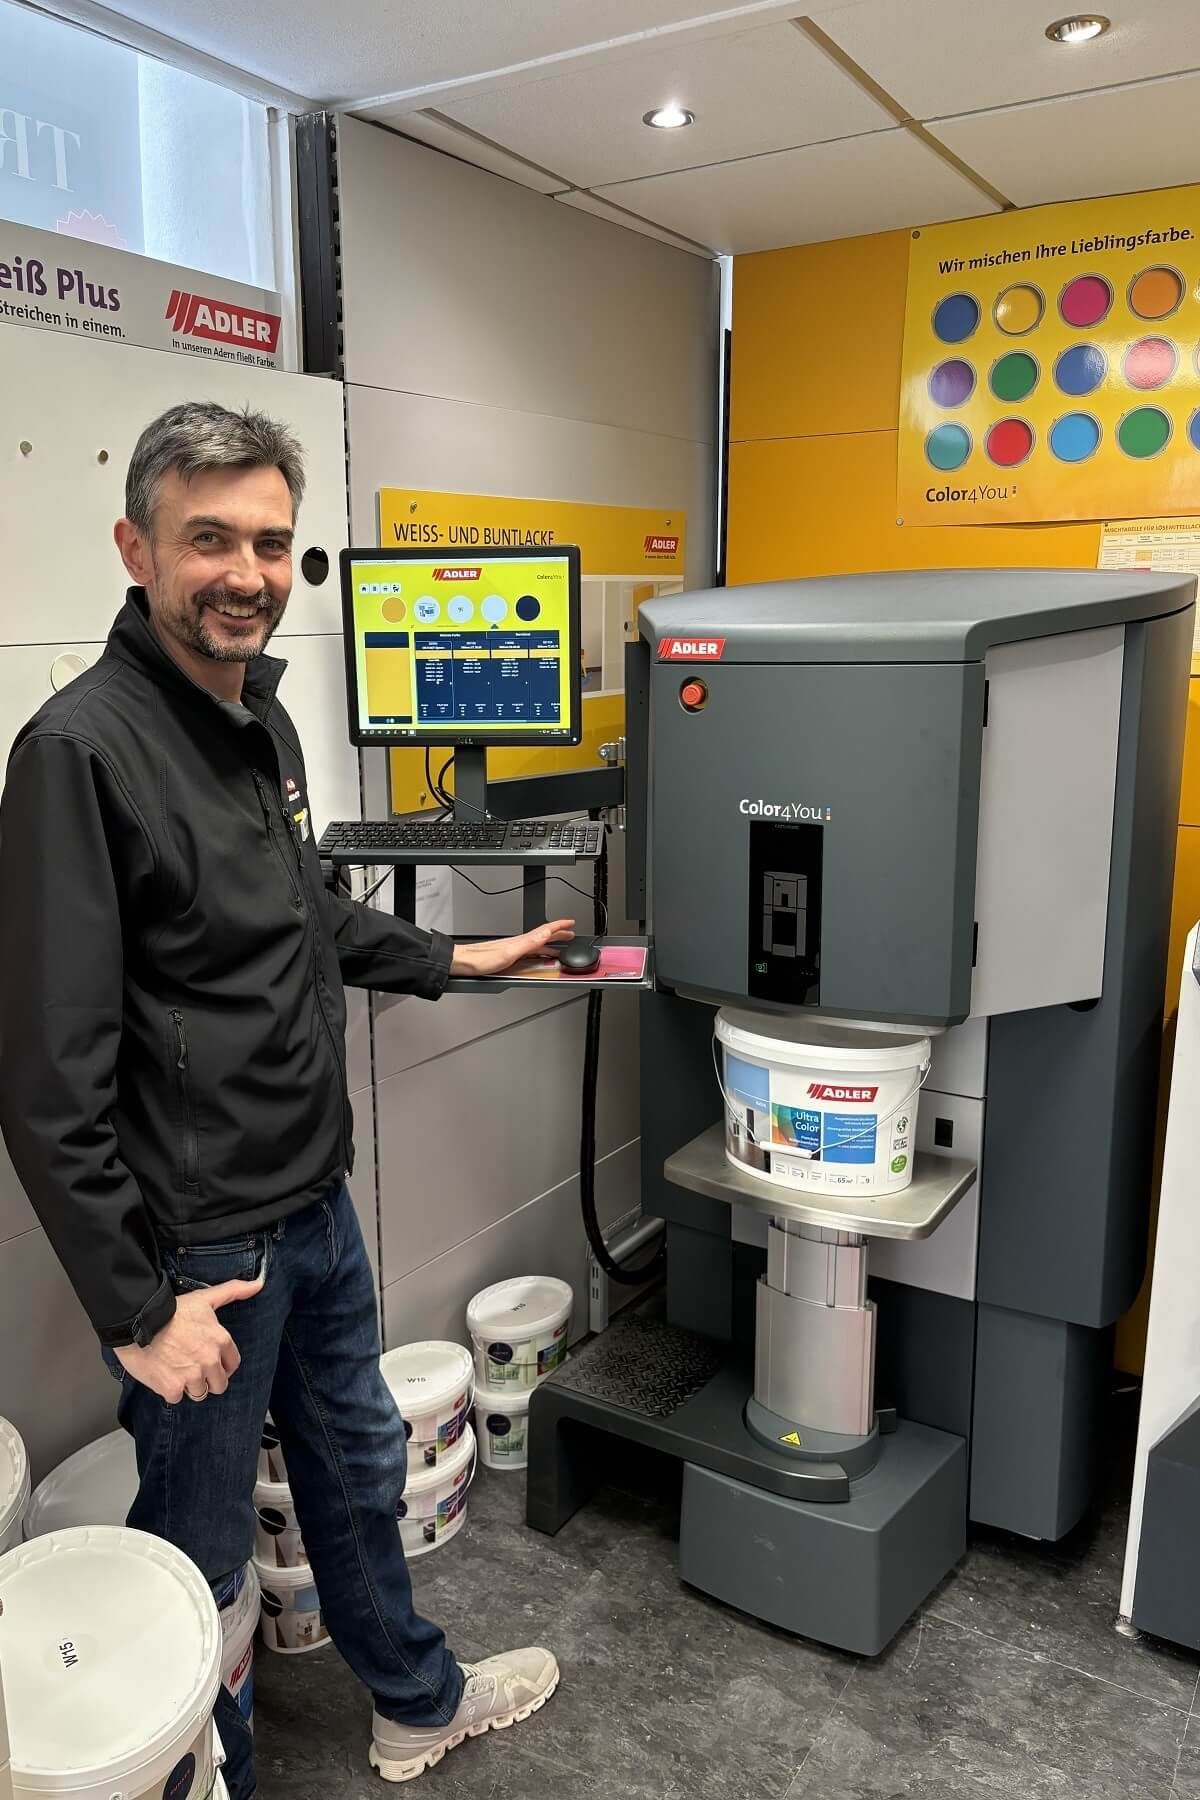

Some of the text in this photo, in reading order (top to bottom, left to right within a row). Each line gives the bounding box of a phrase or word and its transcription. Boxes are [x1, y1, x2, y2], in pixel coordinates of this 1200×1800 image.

[938, 227, 1195, 275] Wir mischen Ihre Lieblingsfarbe.
[56, 267, 121, 312] Plus
[65, 312, 78, 329] in
[82, 319, 126, 338] einem.
[194, 304, 272, 344] ADLER
[172, 338, 180, 348] In
[182, 342, 212, 356] unseren
[213, 346, 235, 360] Adern
[256, 356, 277, 369] Farbe.
[925, 484, 1008, 504] Color4You
[393, 522, 444, 543] WEISS-
[448, 525, 480, 545] UND
[651, 538, 676, 550] ADLER
[442, 570, 478, 579] ADLER
[671, 641, 718, 655] ADLER
[739, 799, 823, 822] Color4You
[822, 1087, 872, 1100] ADLER
[795, 1121, 820, 1133] Color
[796, 1111, 820, 1123] Ultra
[59, 1641, 79, 1668] W15
